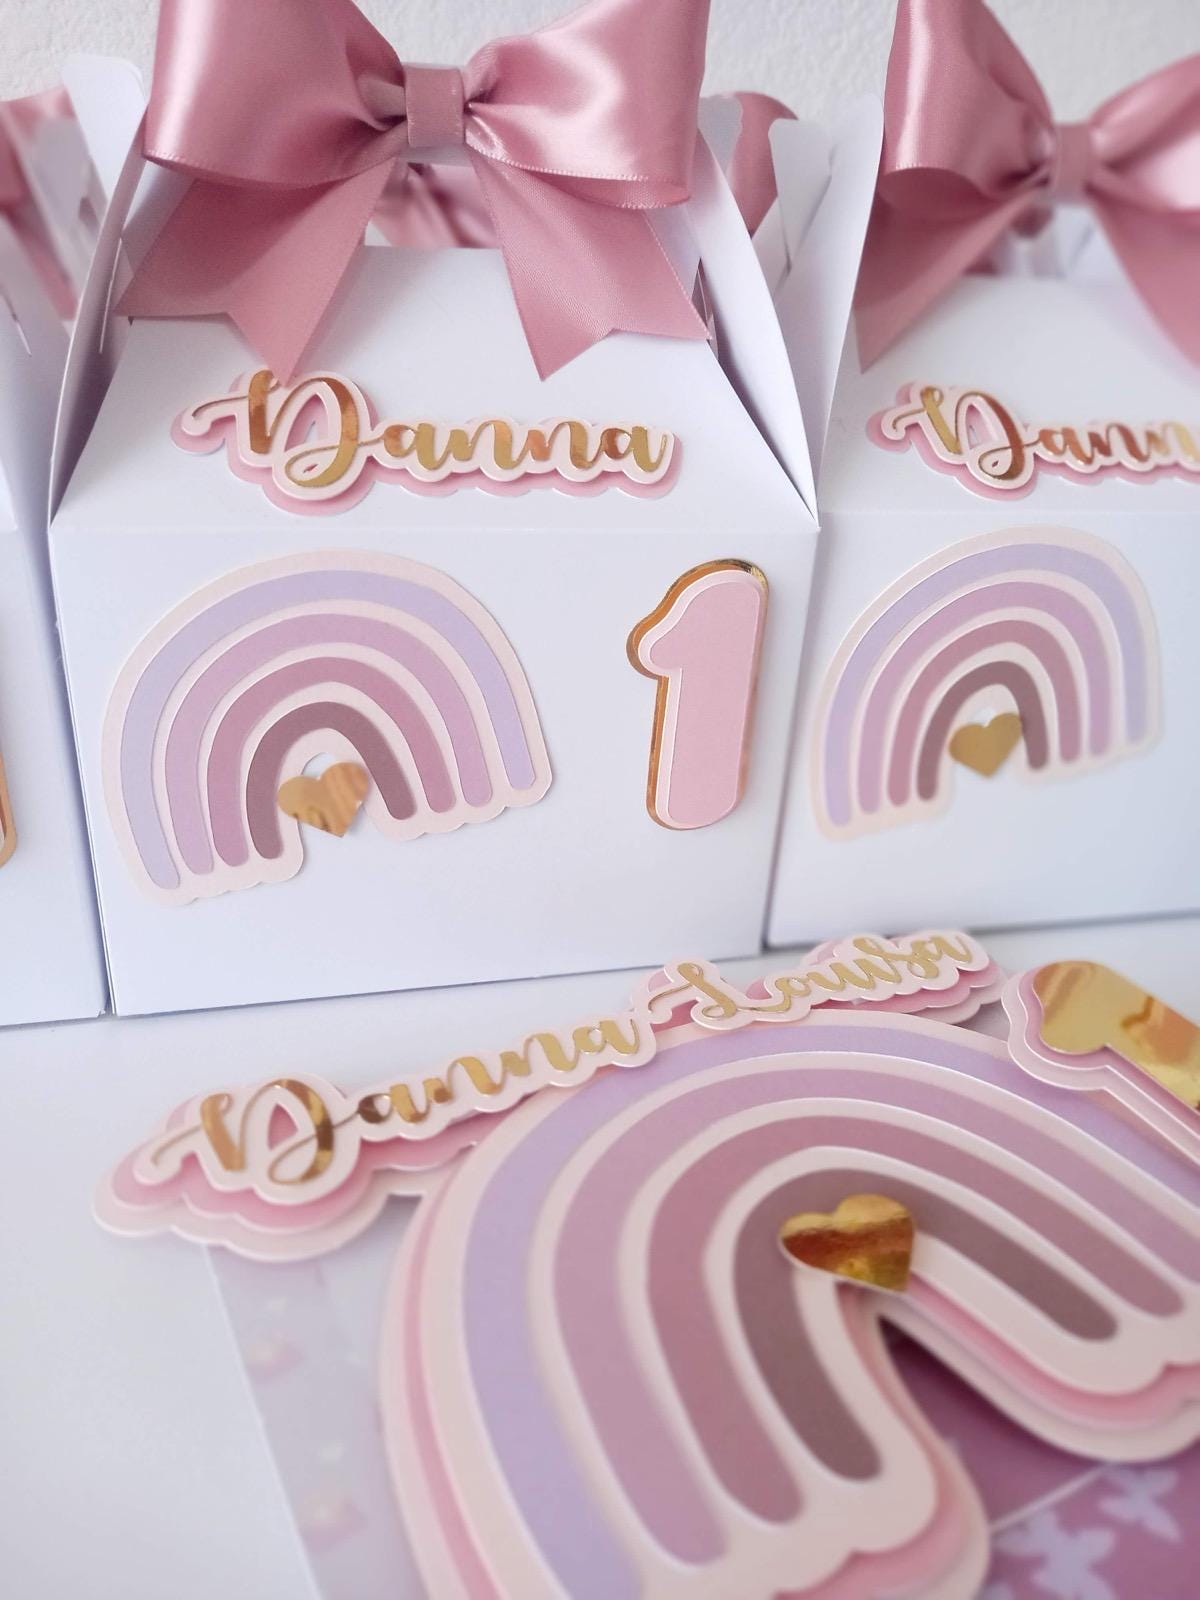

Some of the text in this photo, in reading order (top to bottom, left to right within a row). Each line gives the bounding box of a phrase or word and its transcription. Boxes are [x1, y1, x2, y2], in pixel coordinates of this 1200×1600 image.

[191, 369, 668, 487] Danna
[625, 558, 769, 831] 1
[151, 1018, 640, 1185] Danna
